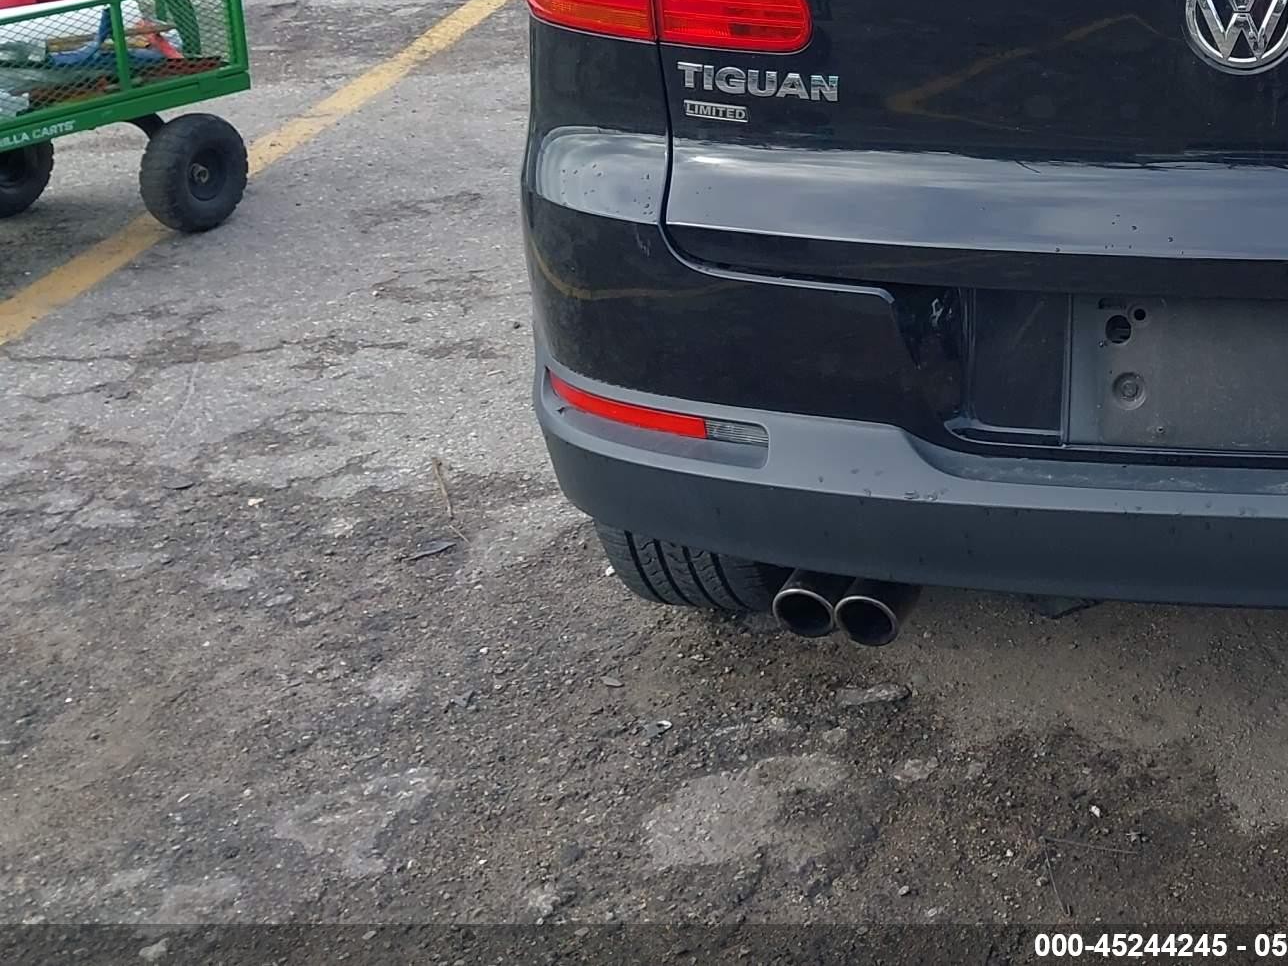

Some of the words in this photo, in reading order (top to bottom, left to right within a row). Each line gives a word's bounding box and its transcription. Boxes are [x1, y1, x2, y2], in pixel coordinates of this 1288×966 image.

[677, 61, 839, 102] TIGUAN
[685, 102, 747, 120] LIMITED
[32, 120, 75, 138] CARTS
